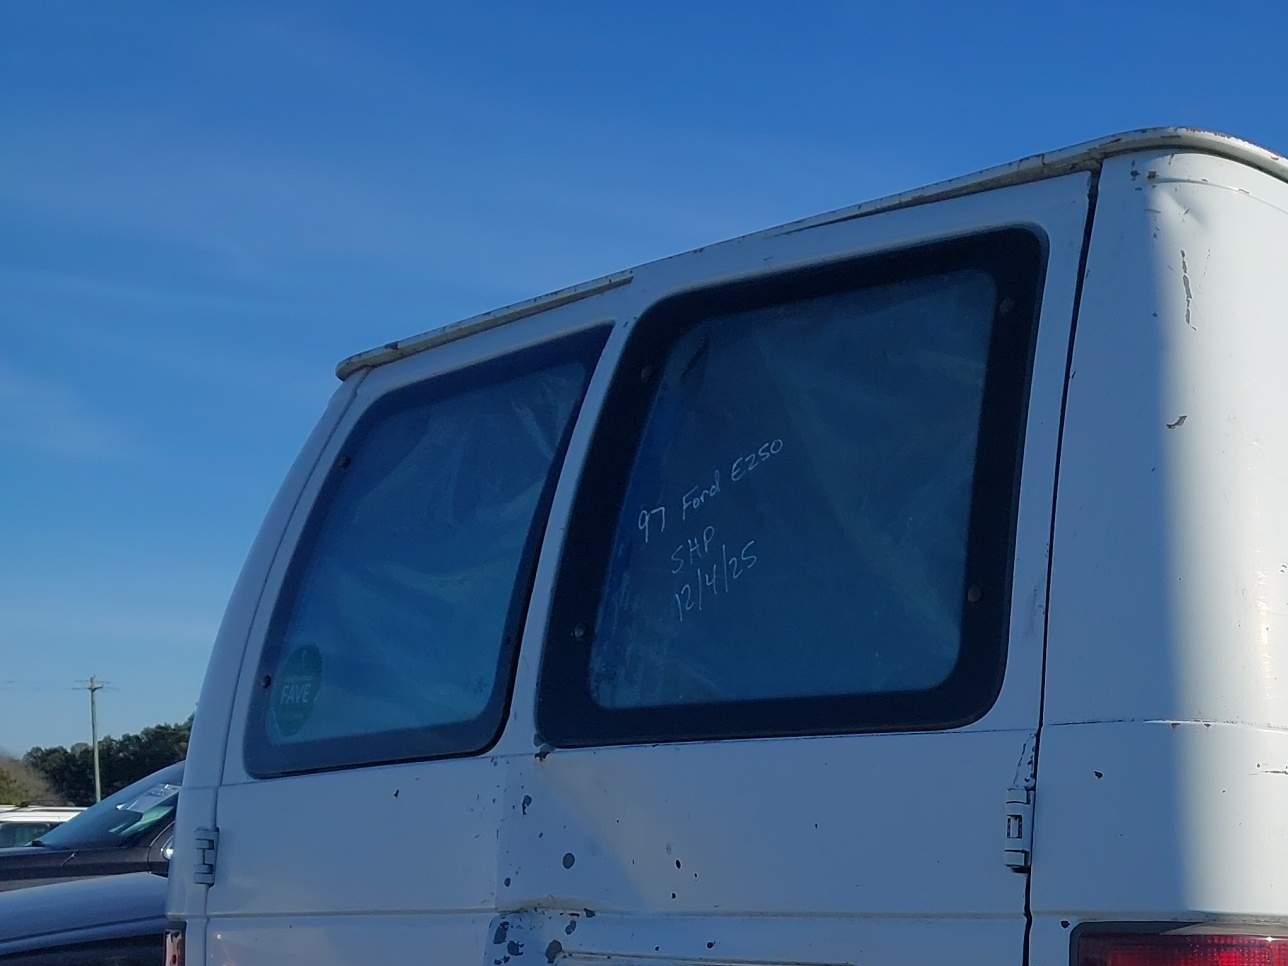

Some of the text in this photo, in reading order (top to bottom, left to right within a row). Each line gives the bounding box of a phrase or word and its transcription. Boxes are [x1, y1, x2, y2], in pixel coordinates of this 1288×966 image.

[637, 438, 783, 544] 97 Ford E250
[670, 525, 715, 575] SHP
[673, 540, 758, 622] 12/4/25
